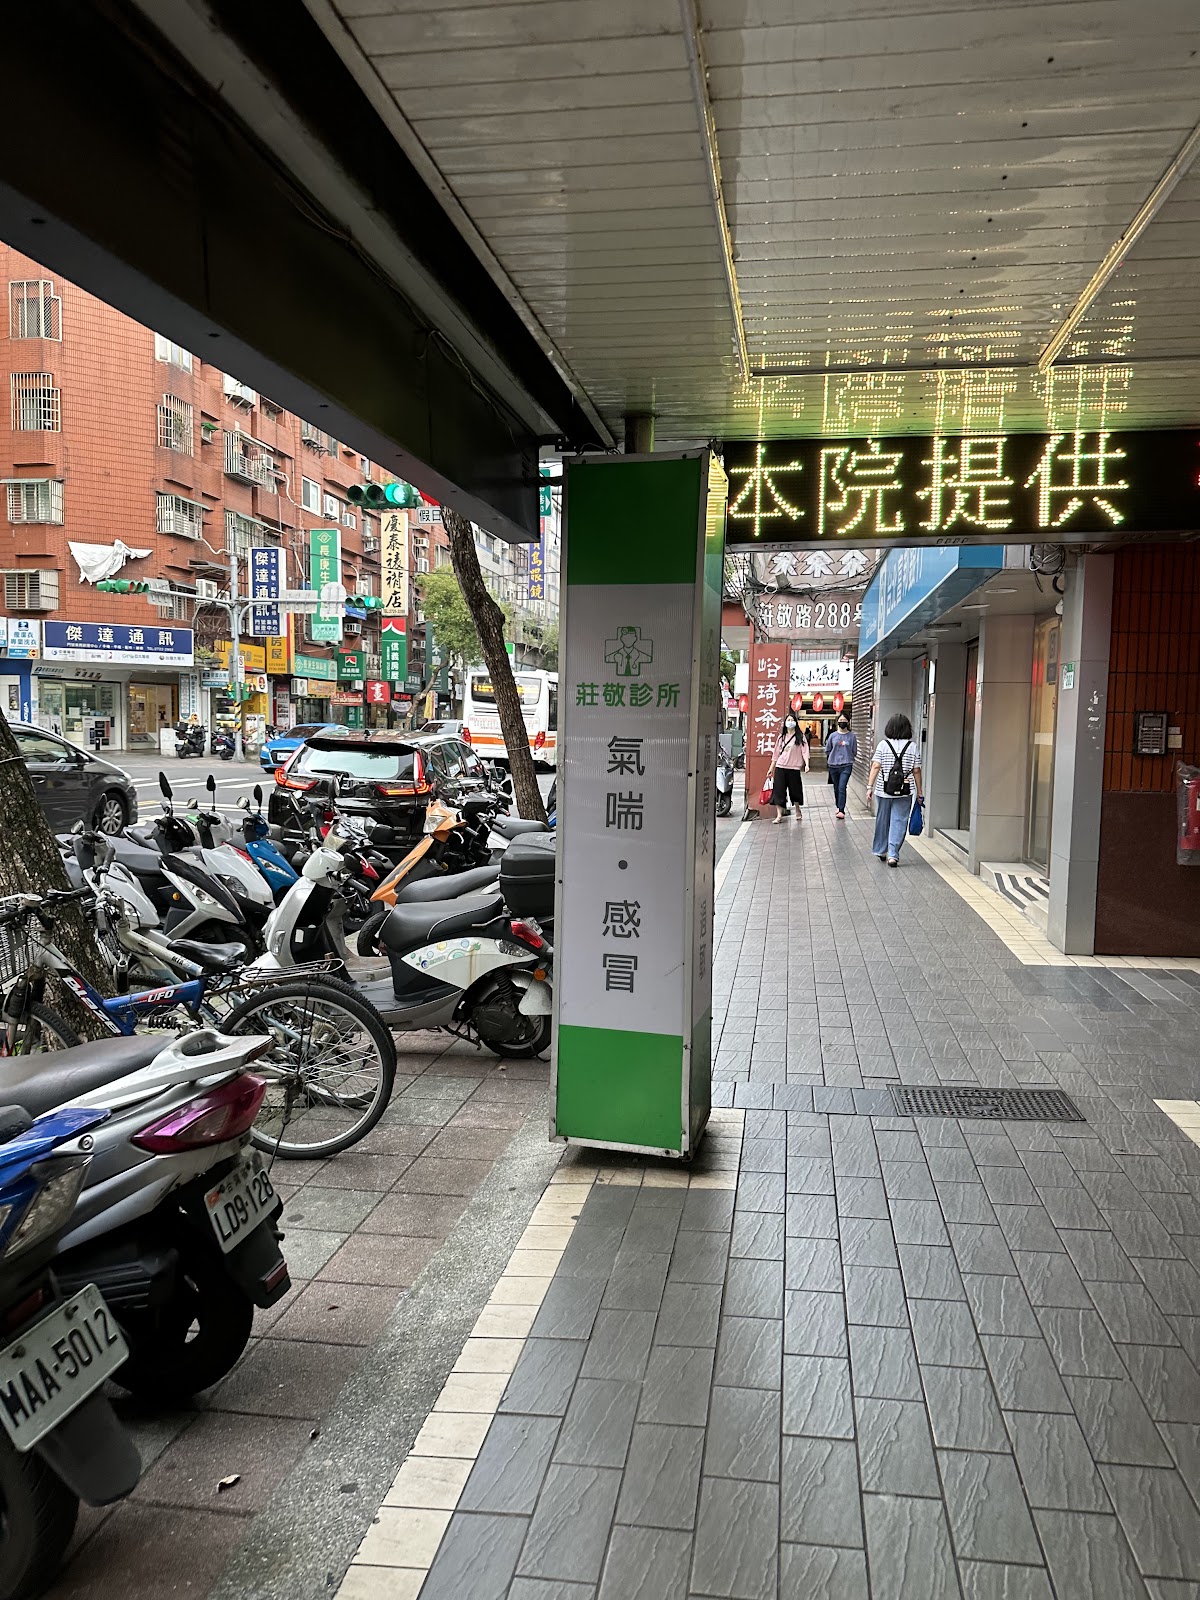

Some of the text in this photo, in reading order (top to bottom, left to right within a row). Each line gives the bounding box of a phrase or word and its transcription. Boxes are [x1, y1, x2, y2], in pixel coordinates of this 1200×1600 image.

[728, 432, 1130, 537] 本院提供
[254, 551, 270, 617] 傑達通訊
[65, 625, 174, 646] 傑達通訊
[575, 682, 681, 708] 莊敬診所
[147, 989, 175, 1003] UFO
[213, 1170, 274, 1243] LD9-128
[0, 1306, 119, 1428] MAA-5012
